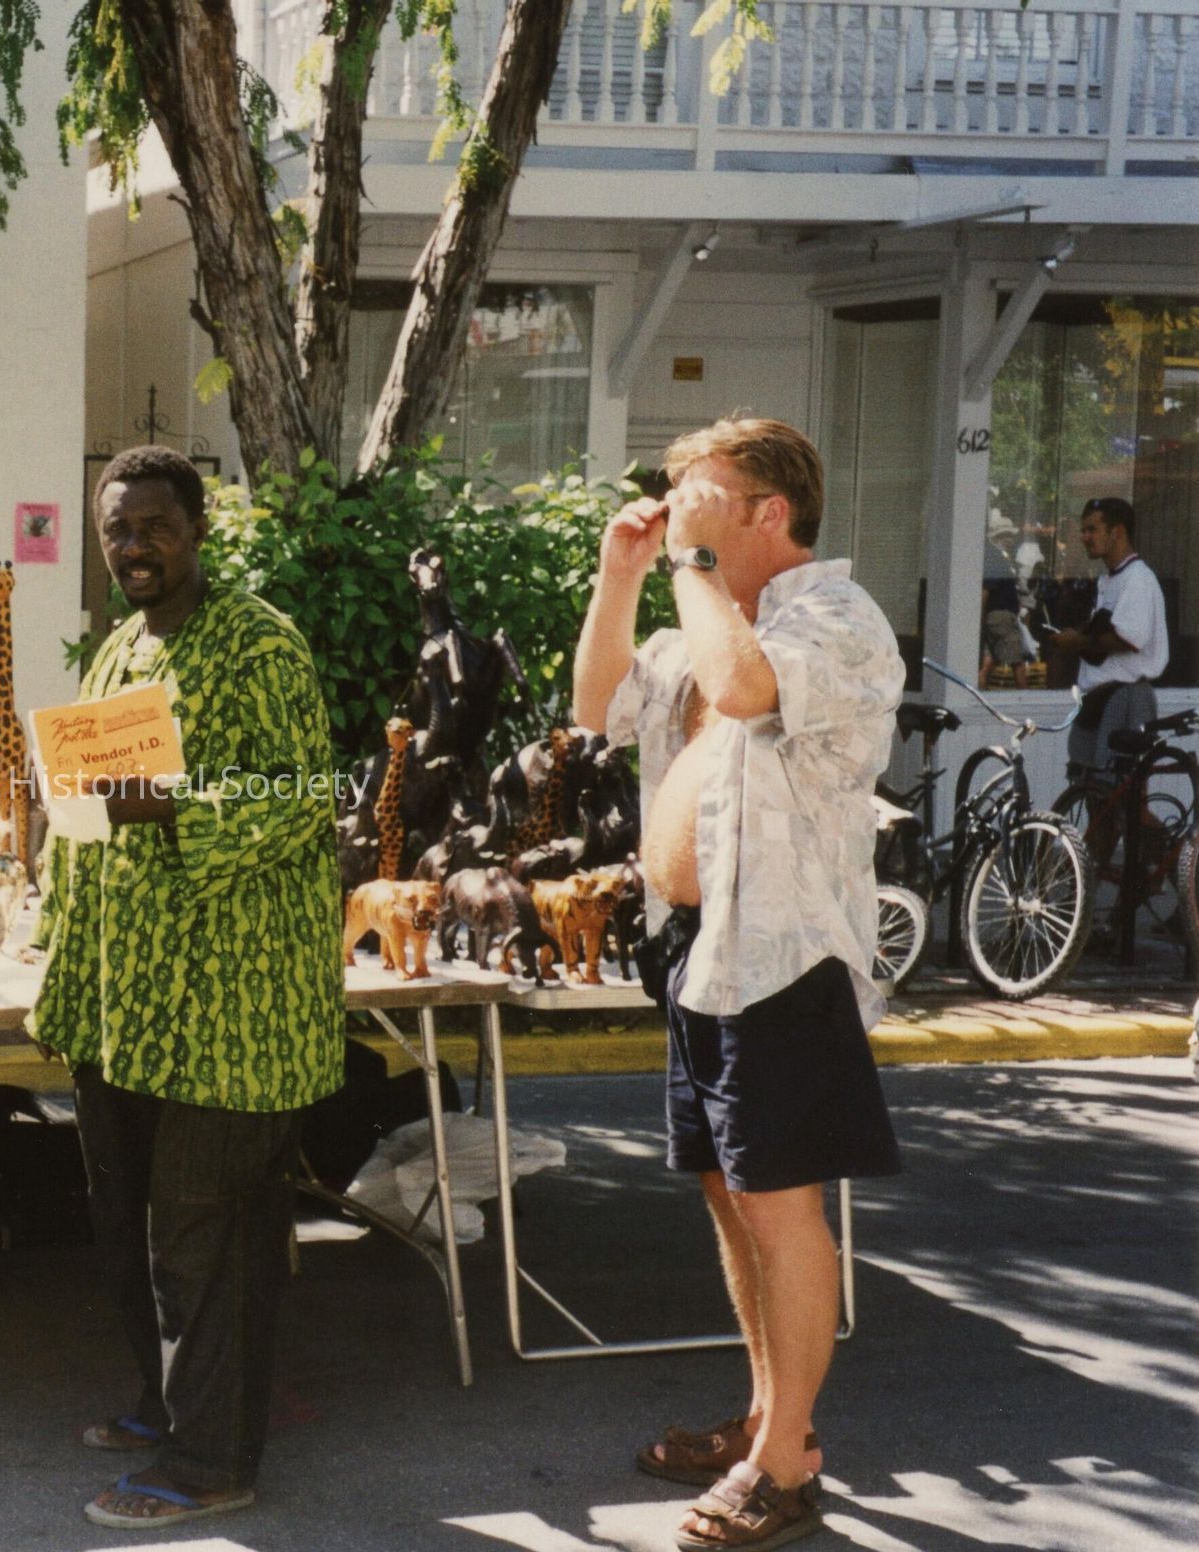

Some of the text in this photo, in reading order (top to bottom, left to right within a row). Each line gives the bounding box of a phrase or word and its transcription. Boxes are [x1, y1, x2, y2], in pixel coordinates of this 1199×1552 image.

[957, 427, 990, 455] 612
[80, 736, 165, 764] Vendor I.D.
